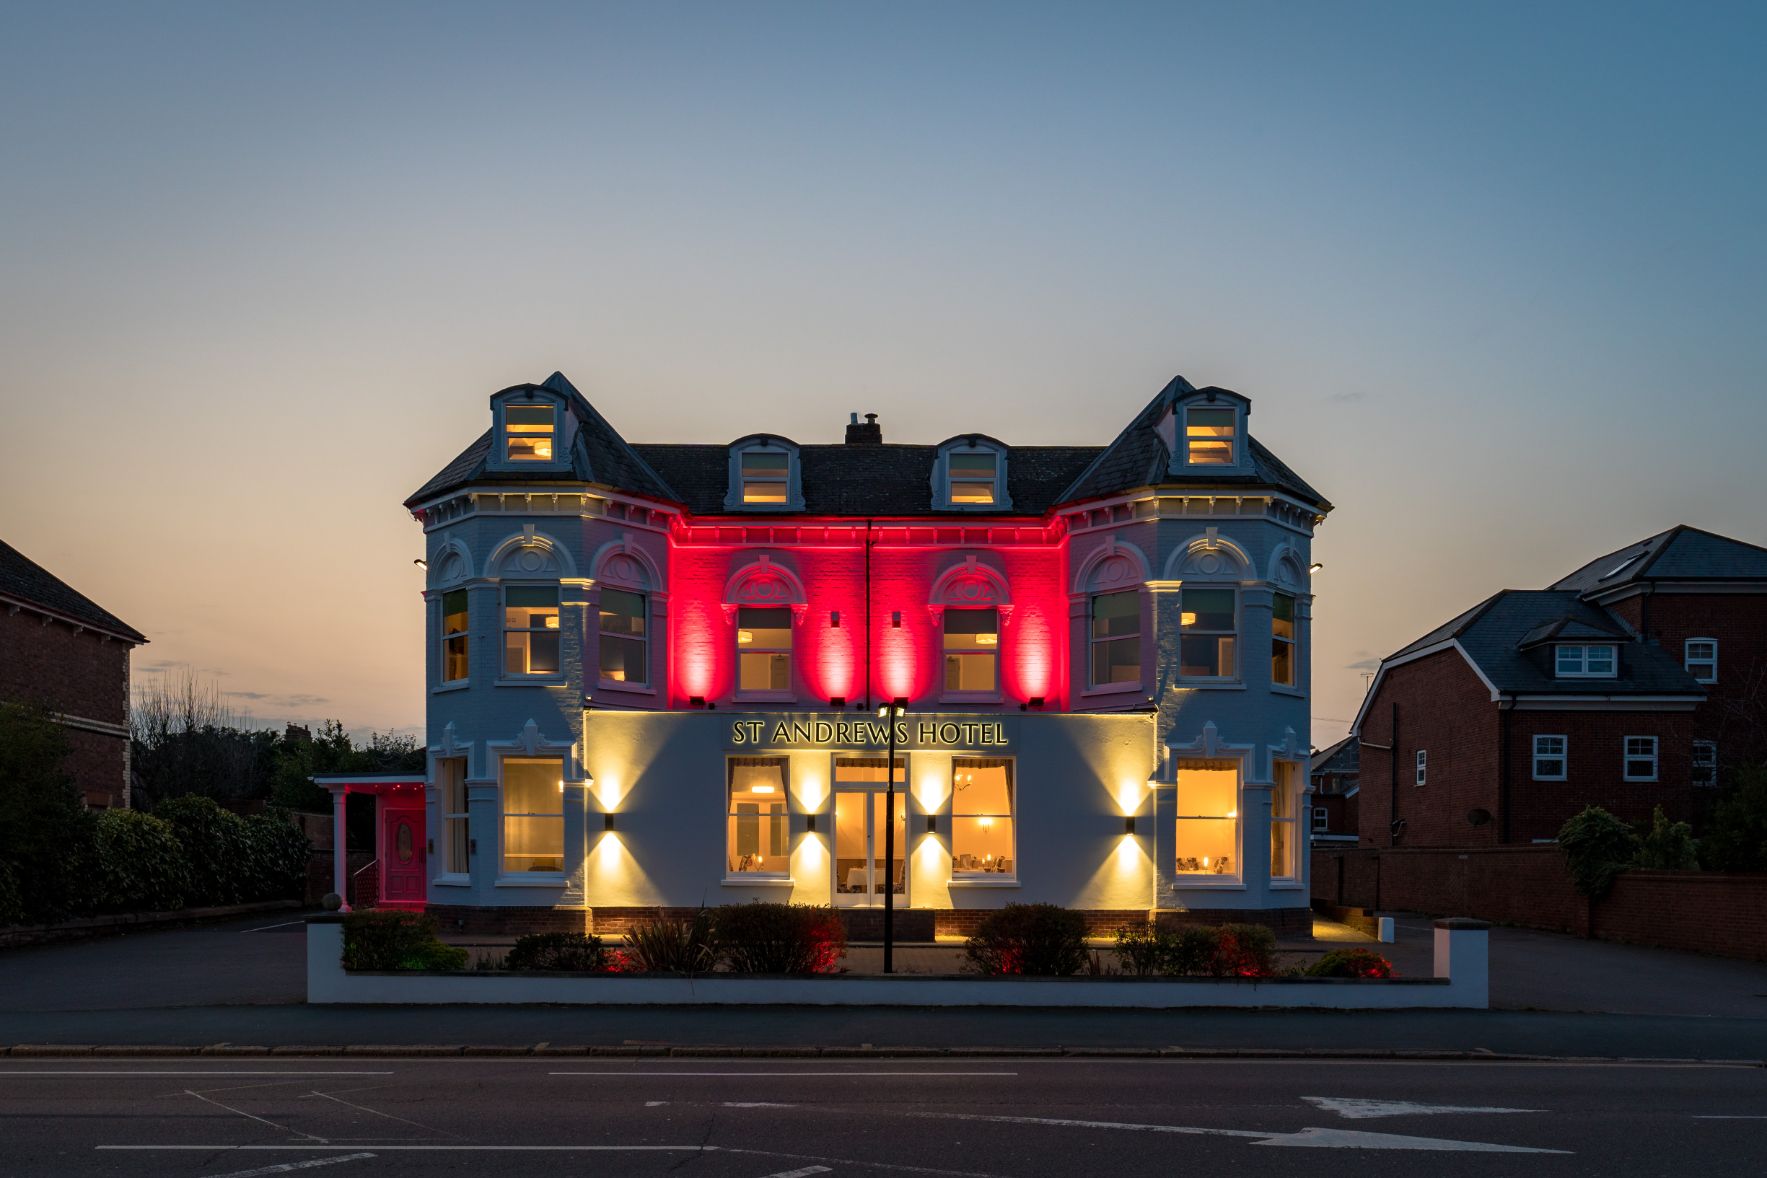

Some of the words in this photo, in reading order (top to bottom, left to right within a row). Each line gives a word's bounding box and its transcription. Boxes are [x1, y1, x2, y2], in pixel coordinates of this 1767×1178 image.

[733, 721, 764, 743] ST
[773, 721, 908, 744] ANDREWS
[919, 722, 1008, 744] HOTEL
